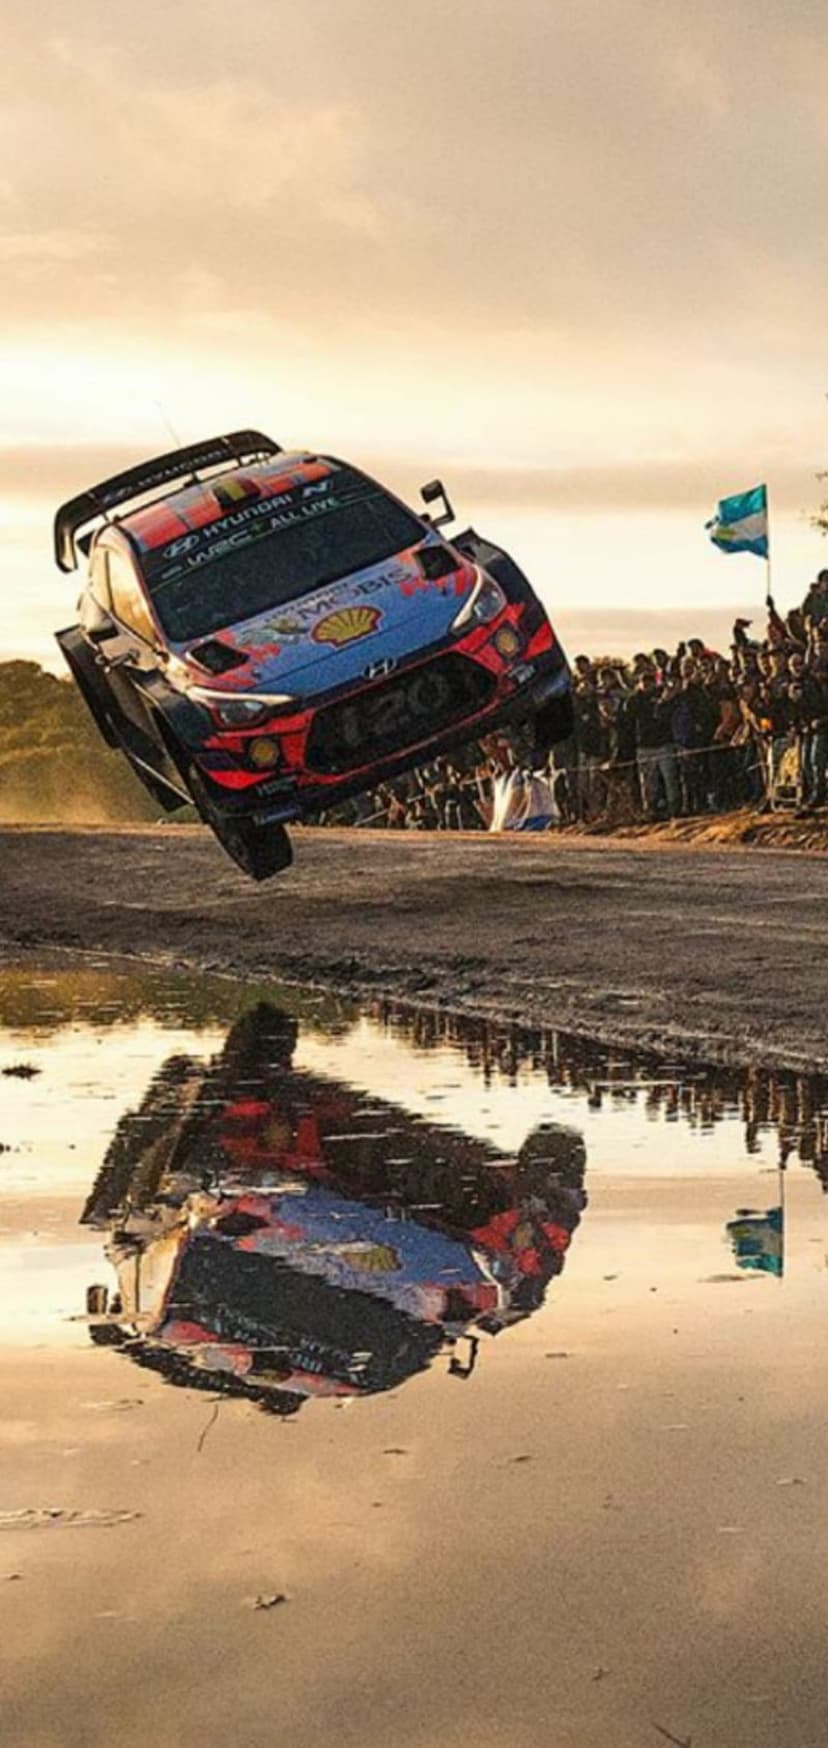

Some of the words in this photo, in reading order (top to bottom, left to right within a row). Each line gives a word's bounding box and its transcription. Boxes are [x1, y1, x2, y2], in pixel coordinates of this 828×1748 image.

[203, 494, 293, 537] HYUNDAI
[269, 512, 300, 529] ALL
[301, 496, 338, 516] LIVE
[298, 568, 412, 620] MOBIS
